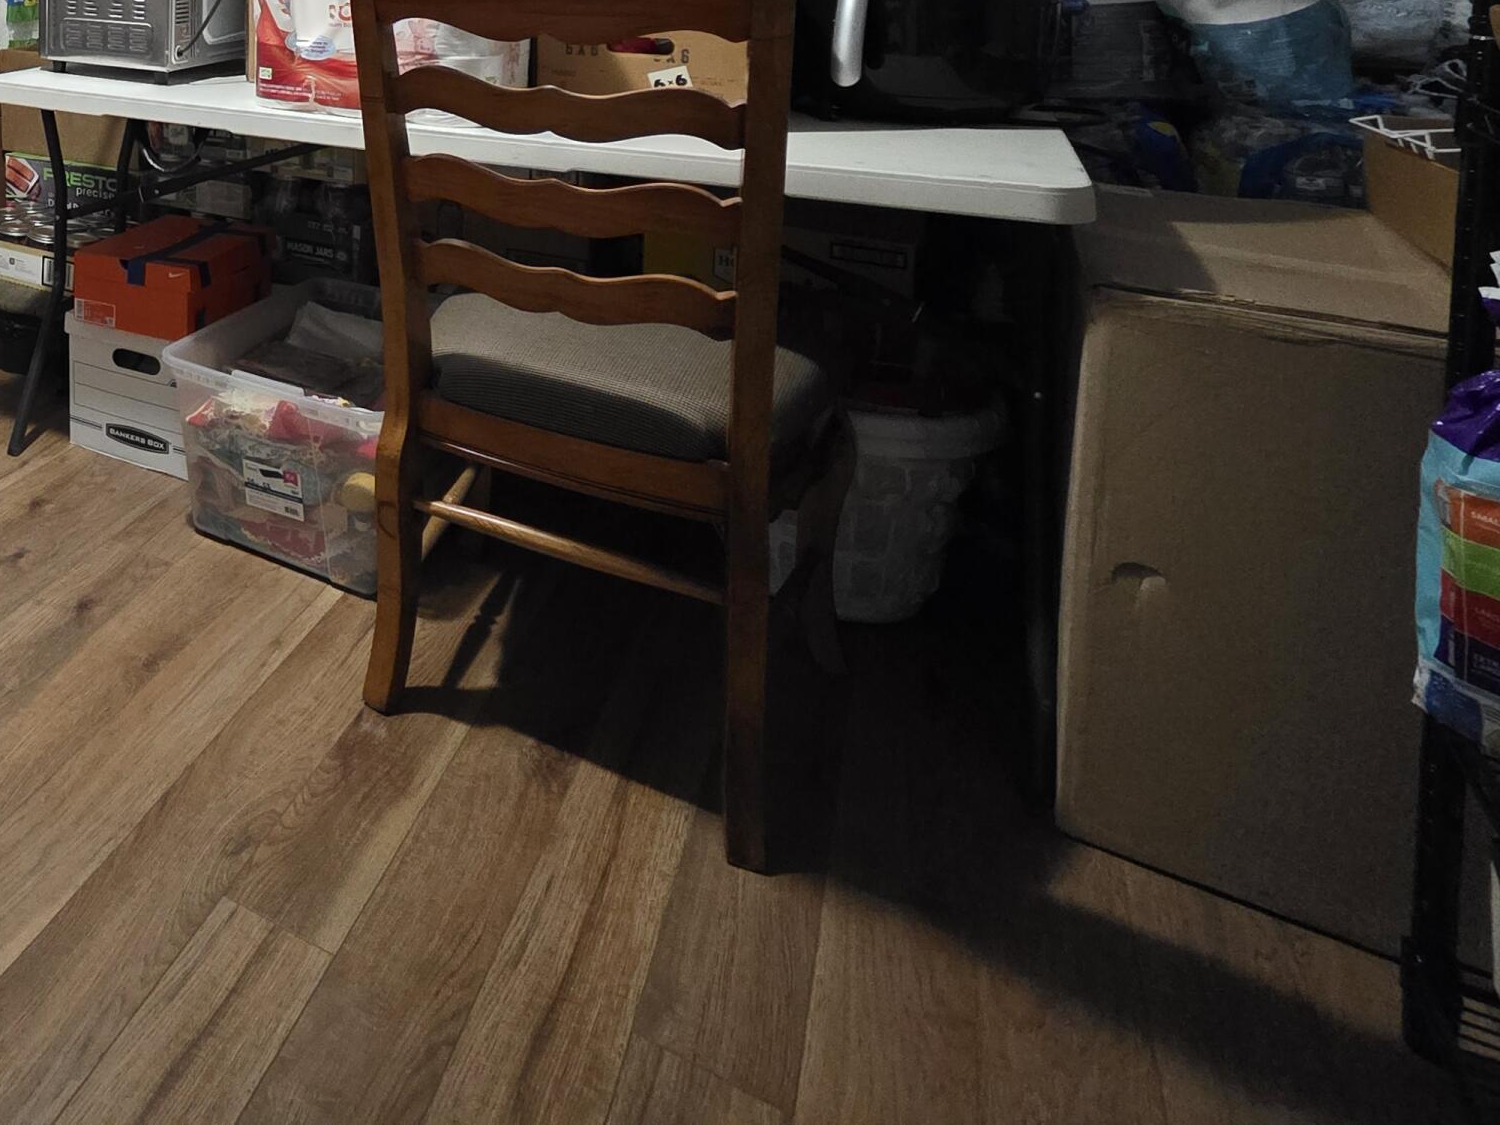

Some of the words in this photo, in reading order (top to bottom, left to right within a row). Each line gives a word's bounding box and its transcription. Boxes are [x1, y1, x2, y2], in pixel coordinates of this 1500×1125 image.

[675, 74, 687, 86] 6
[109, 427, 146, 446] BANKERS
[147, 438, 165, 451] BOX
[1471, 511, 1500, 526] SMAL
